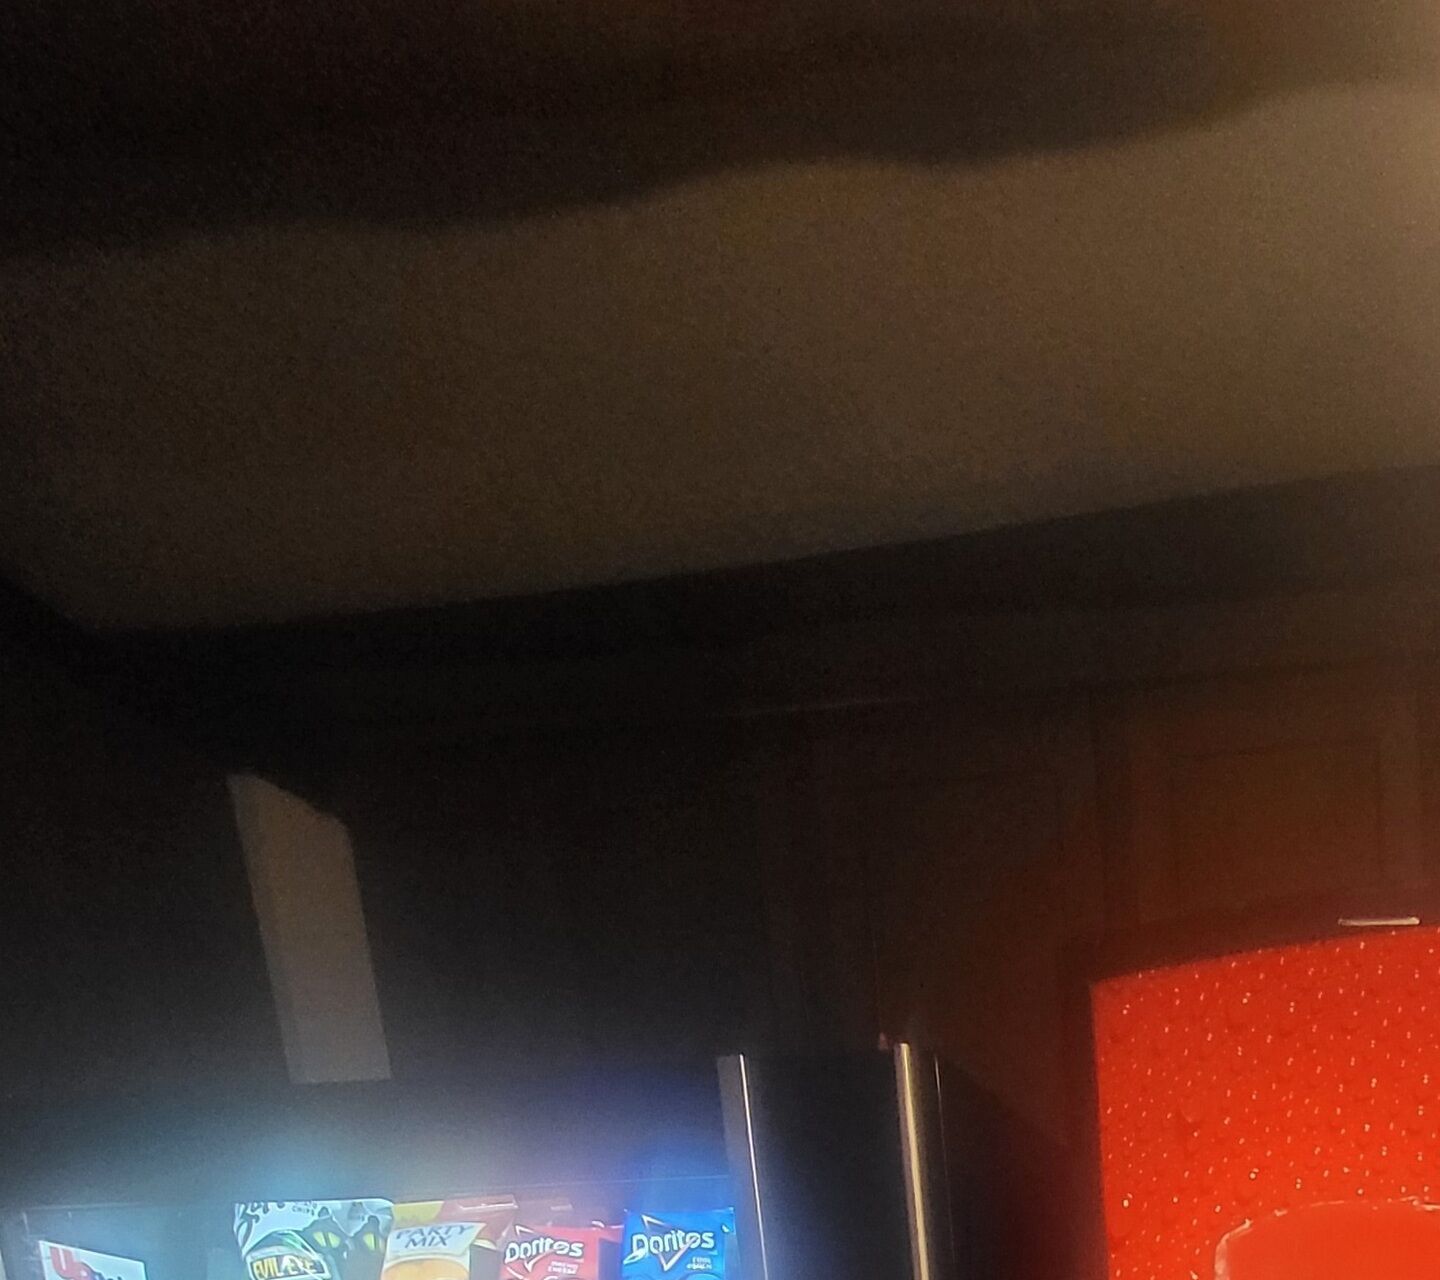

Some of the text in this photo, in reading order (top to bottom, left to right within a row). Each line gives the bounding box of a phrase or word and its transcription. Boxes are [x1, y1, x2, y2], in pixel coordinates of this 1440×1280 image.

[396, 1224, 475, 1240] PARTY
[404, 1236, 451, 1249] MIX
[631, 1229, 716, 1256] Doritos
[504, 1237, 585, 1264] Doritos
